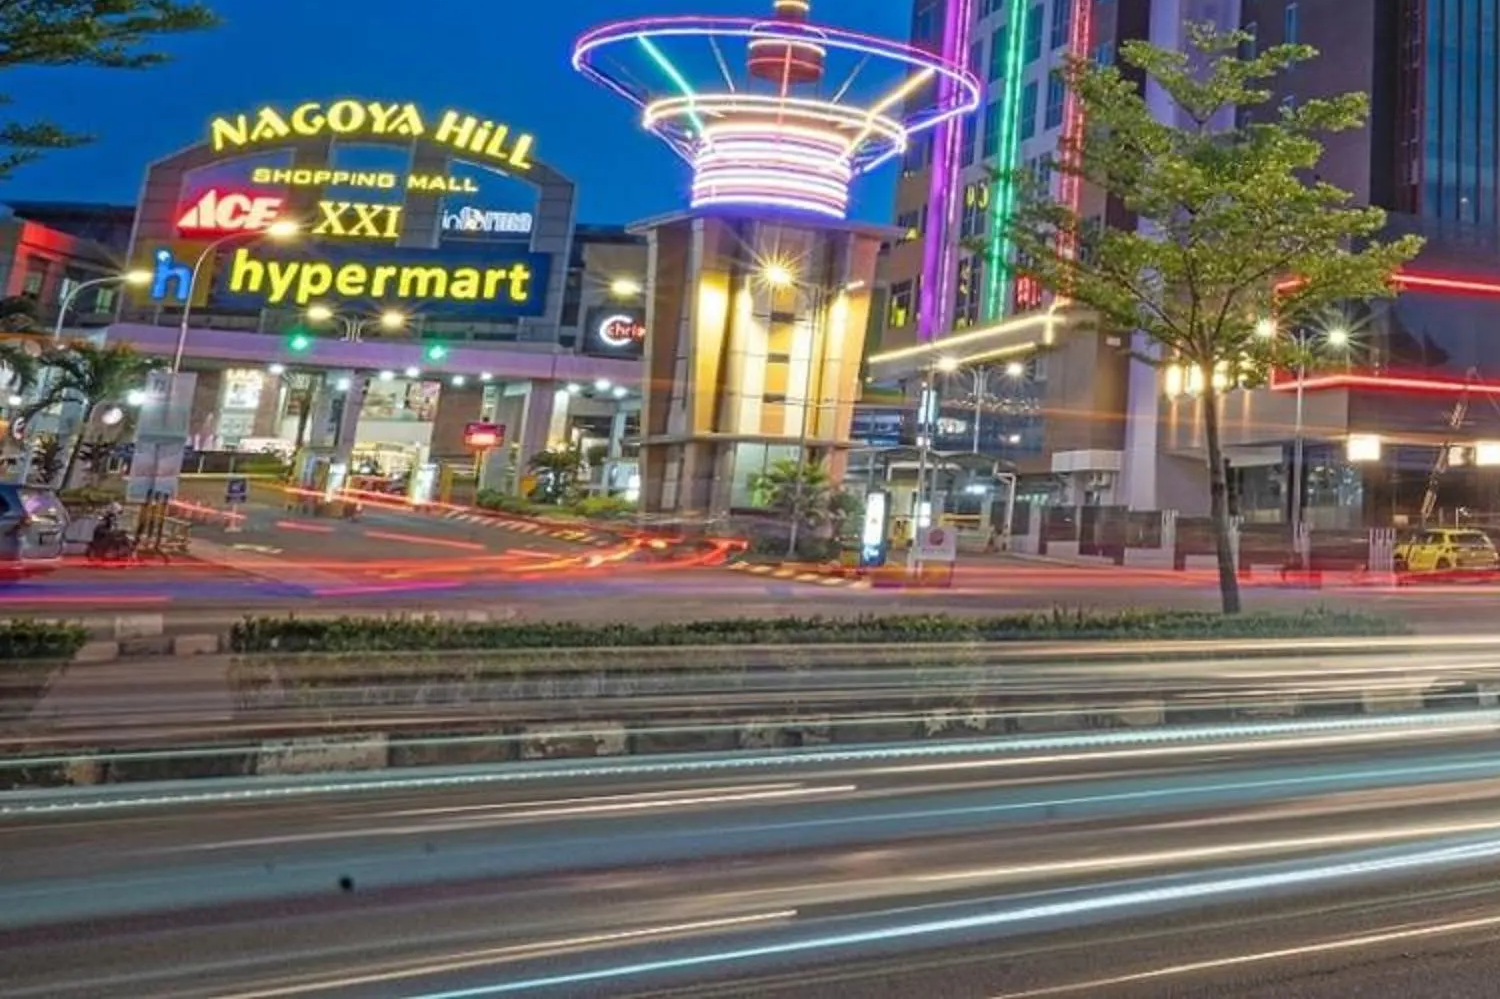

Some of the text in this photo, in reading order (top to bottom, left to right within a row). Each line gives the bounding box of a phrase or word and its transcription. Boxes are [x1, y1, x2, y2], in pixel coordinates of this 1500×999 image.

[211, 100, 425, 152] NAGOYA
[252, 167, 479, 193] SHOPPING MALL
[177, 188, 284, 230] ACE
[311, 200, 403, 238] XXI
[229, 248, 530, 303] hypermart
